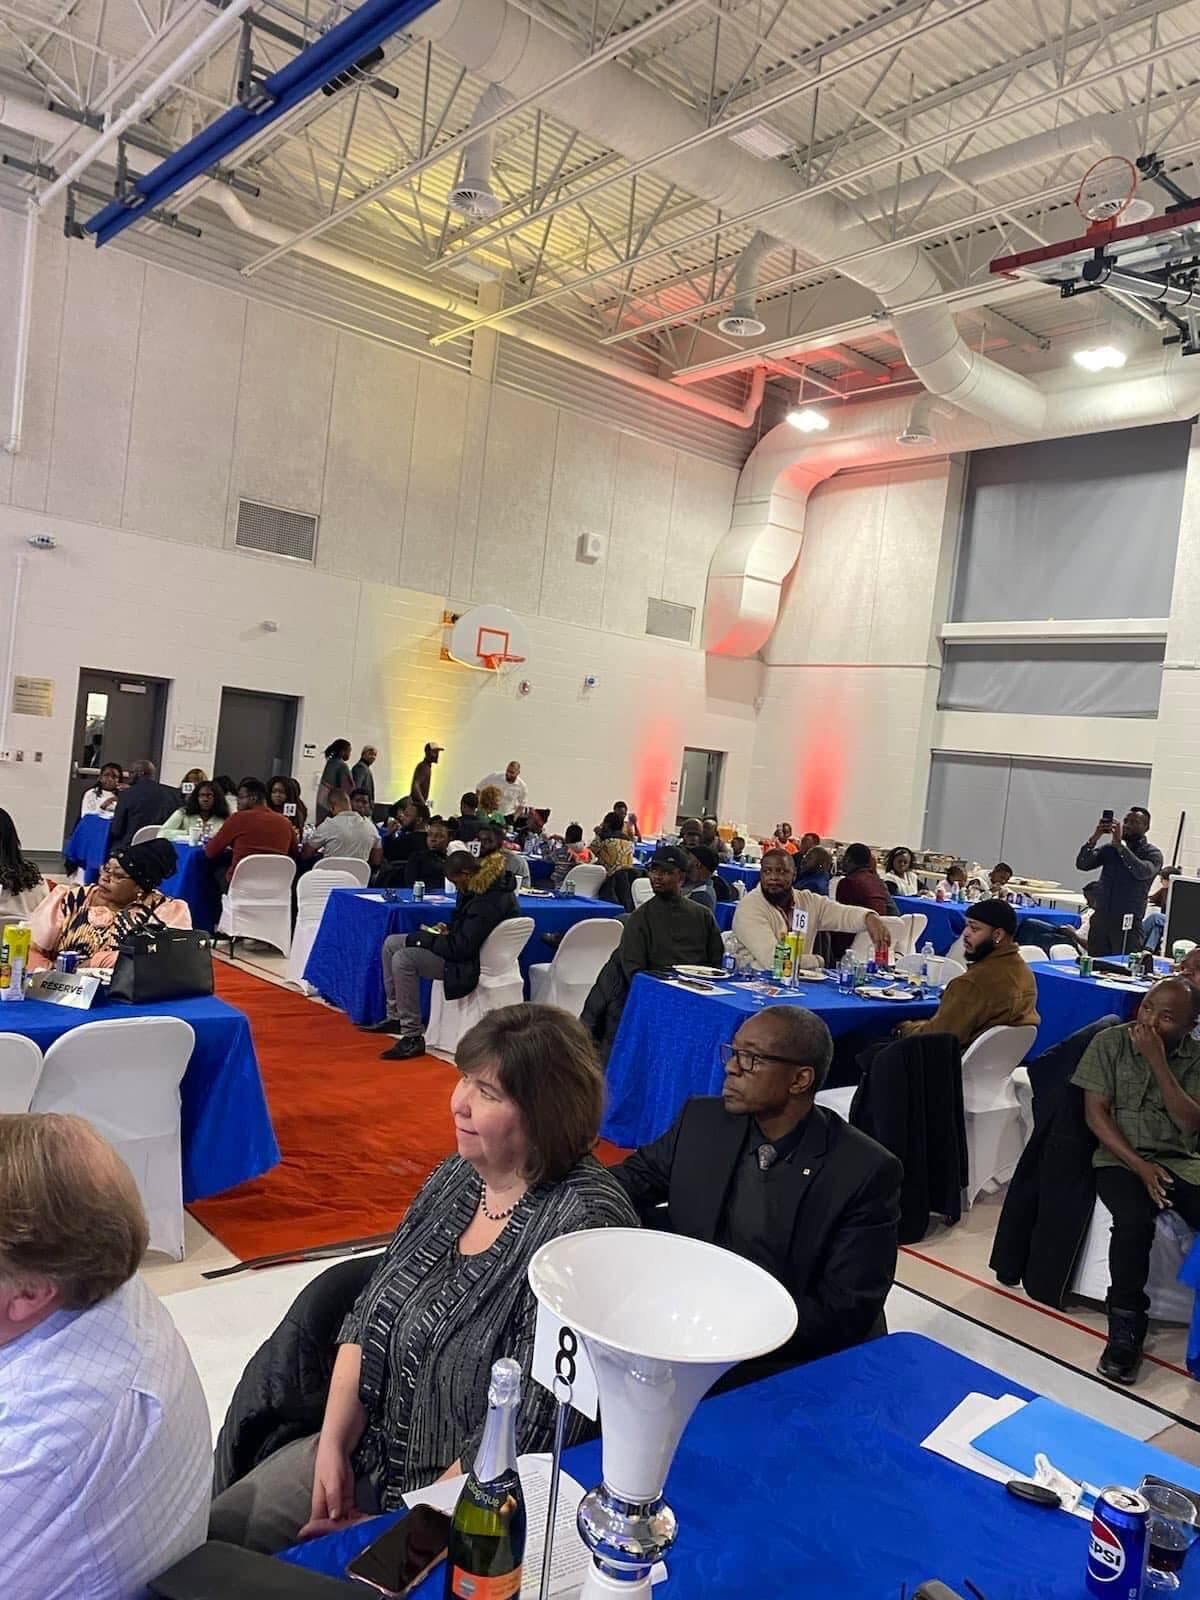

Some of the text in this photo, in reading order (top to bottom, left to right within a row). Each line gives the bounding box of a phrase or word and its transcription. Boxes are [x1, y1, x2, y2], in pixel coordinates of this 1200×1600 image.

[470, 844, 478, 855] 15
[796, 913, 806, 928] 16
[41, 980, 84, 995] RESERVE
[555, 1326, 578, 1386] 8
[1088, 1540, 1121, 1567] EPSI
